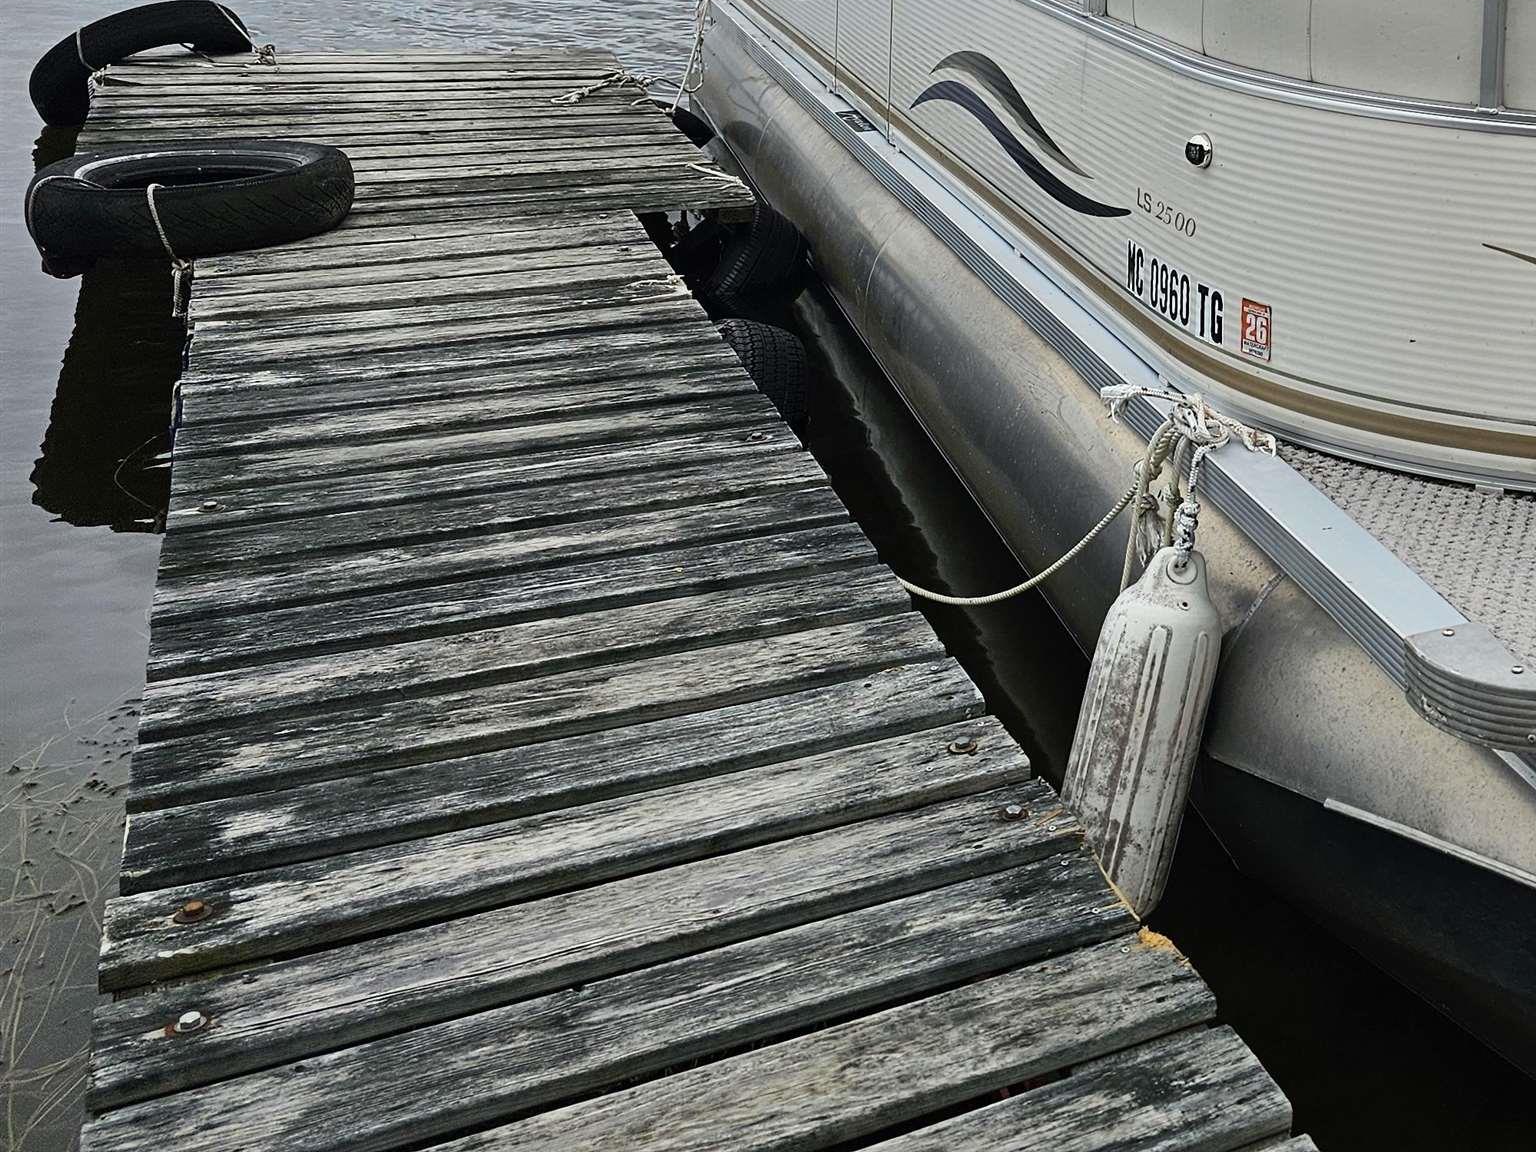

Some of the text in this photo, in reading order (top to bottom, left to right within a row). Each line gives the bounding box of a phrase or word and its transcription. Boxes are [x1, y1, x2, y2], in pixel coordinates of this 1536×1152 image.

[1136, 187, 1196, 237] LS 2500
[1127, 239, 1223, 344] MC 0960 TG
[1246, 312, 1267, 345] 26
